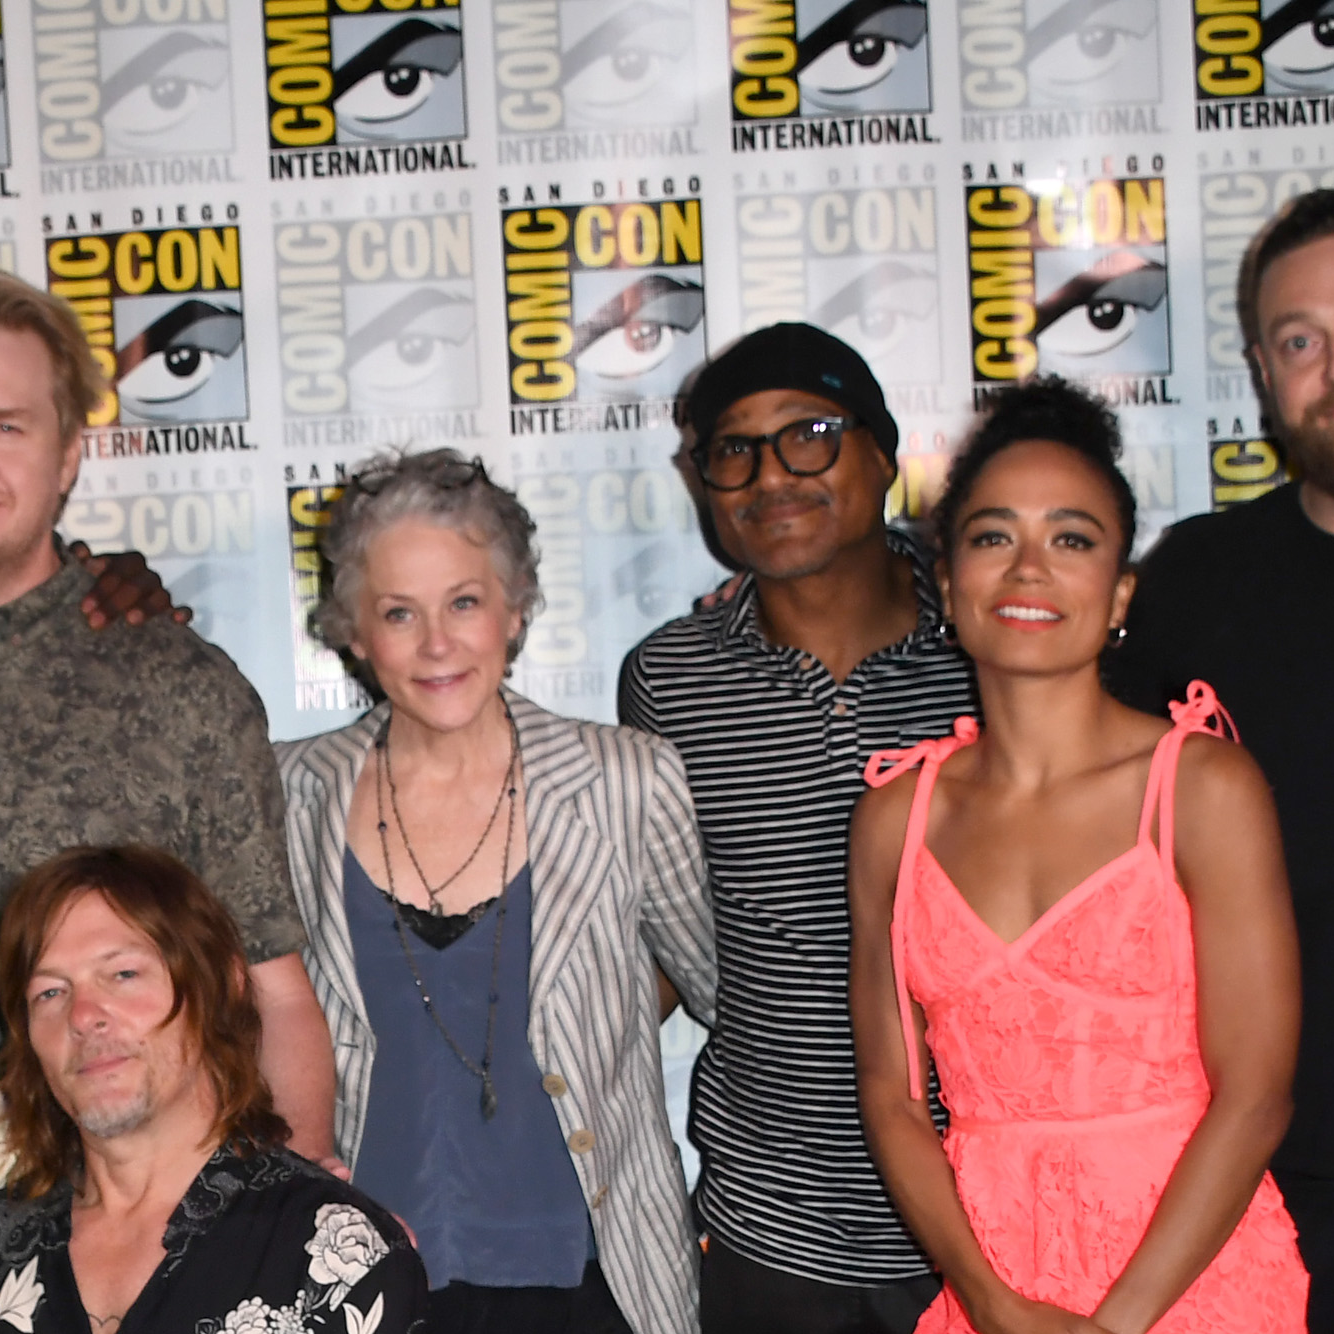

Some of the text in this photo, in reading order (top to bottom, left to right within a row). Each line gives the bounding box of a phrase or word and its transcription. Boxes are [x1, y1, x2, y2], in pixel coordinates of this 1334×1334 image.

[499, 176, 701, 205] SAN DIEGO
[962, 162, 1025, 181] SAN
[41, 204, 239, 233] SAN DIEGO
[573, 199, 703, 268] CON
[809, 189, 935, 254] CON
[1037, 179, 1166, 248] CON
[114, 227, 240, 294] CON
[346, 213, 472, 282] CON
[504, 207, 576, 402] COMIC
[968, 186, 1038, 380] COMIC
[275, 222, 348, 414] COMIC
[284, 463, 346, 482] SAN
[131, 491, 254, 557] CON
